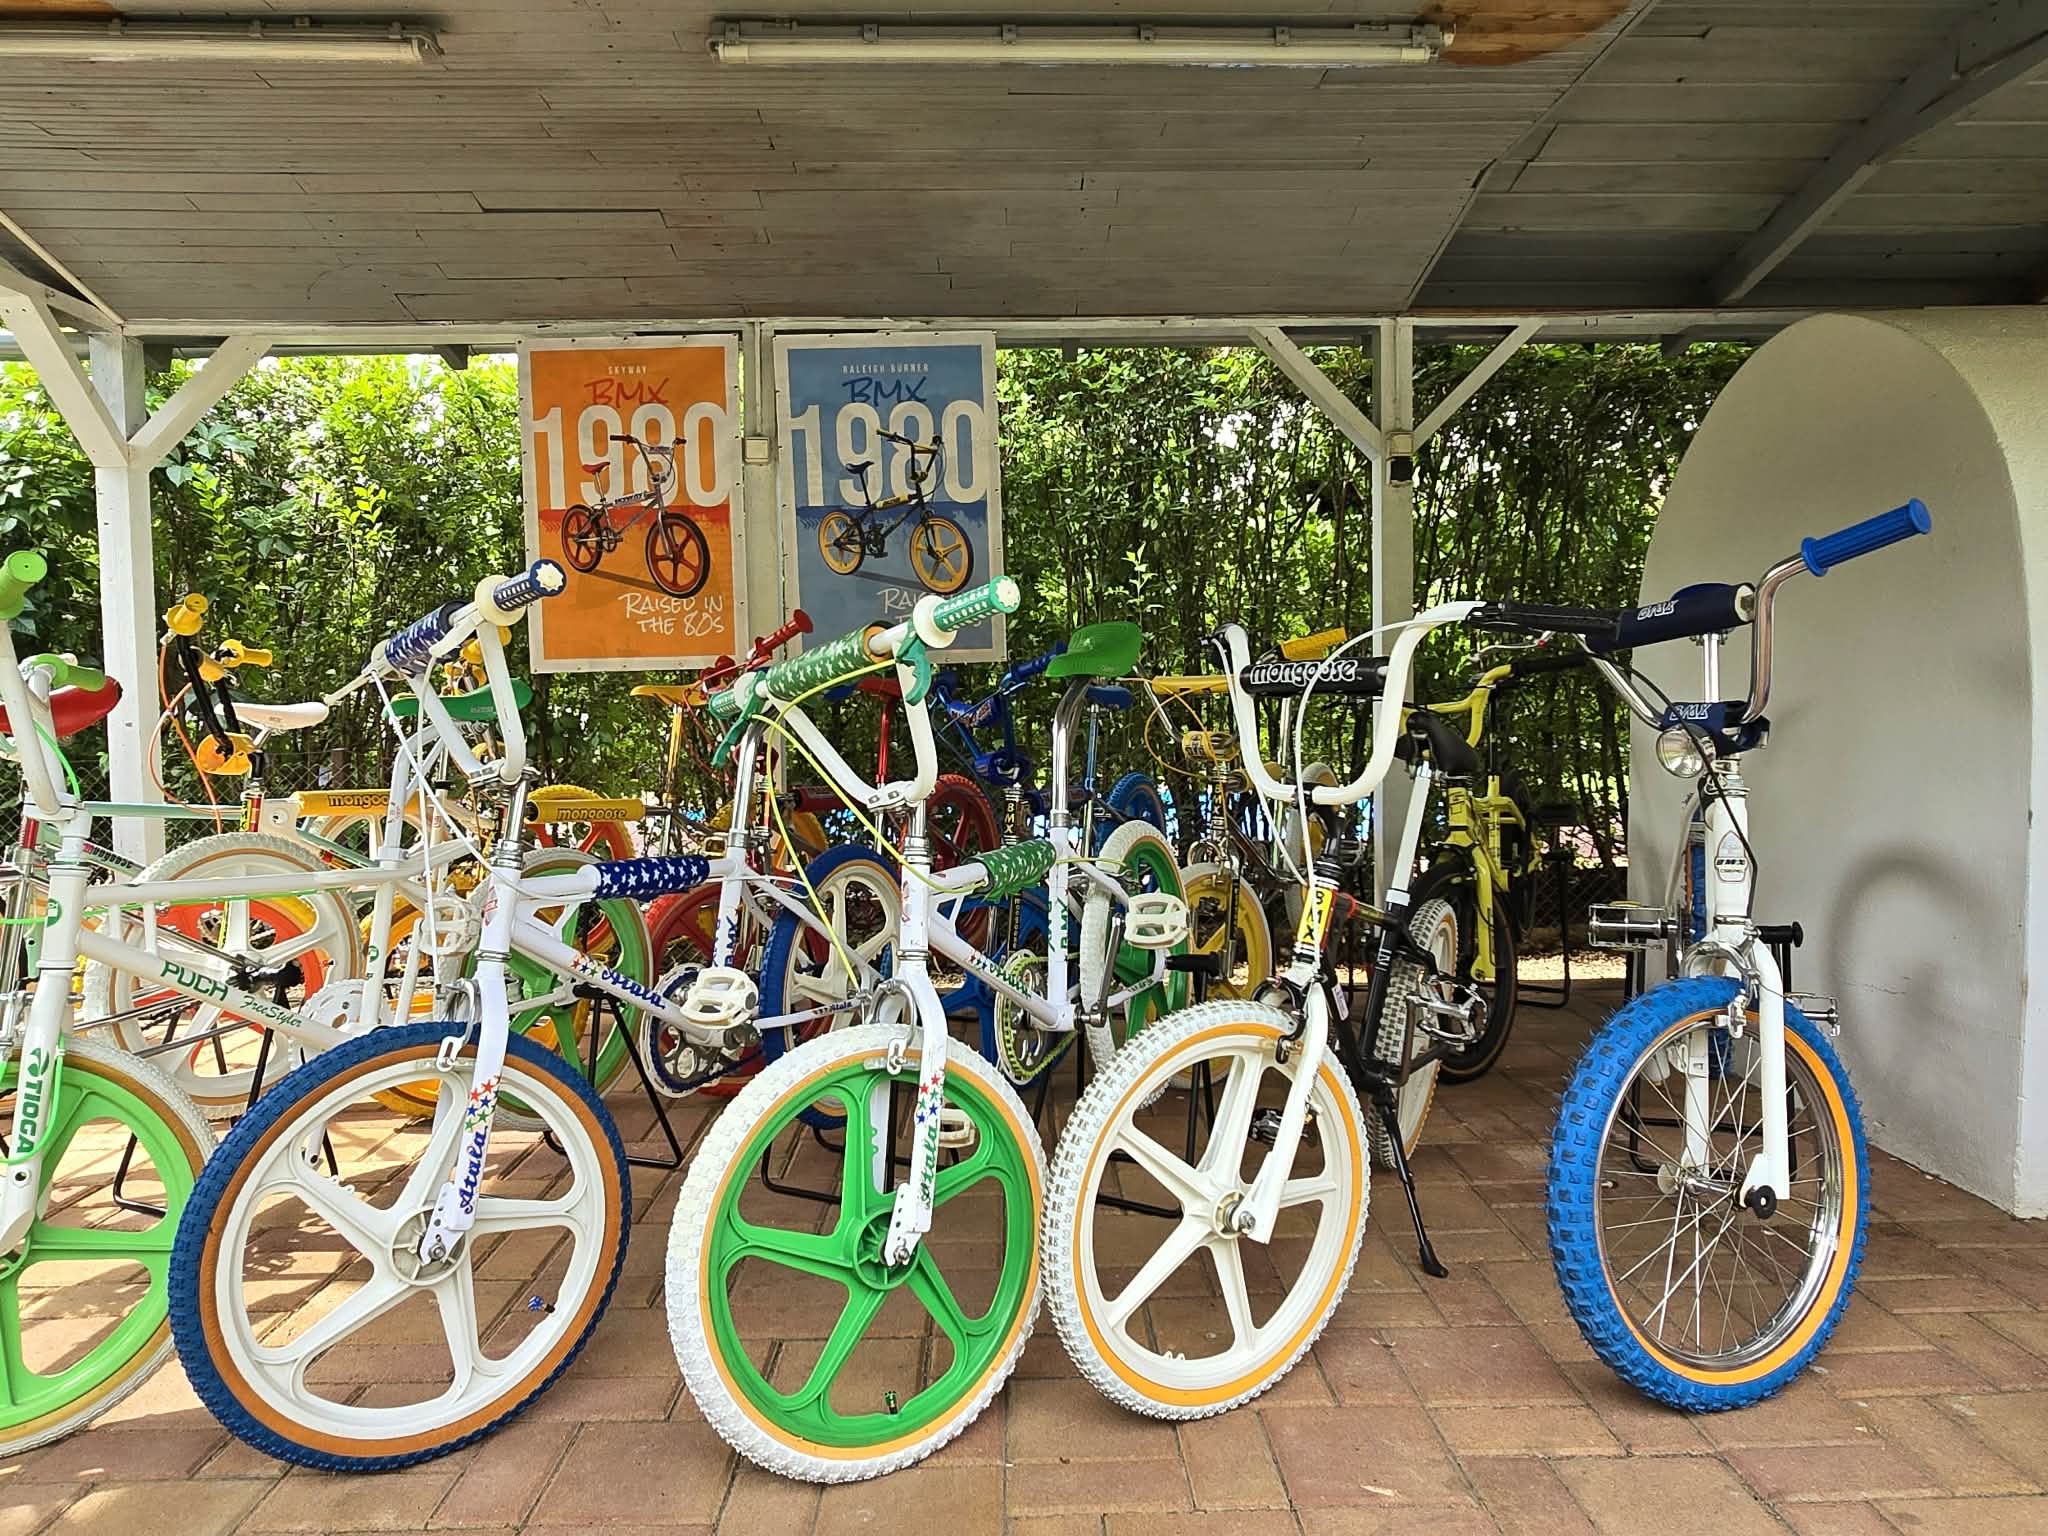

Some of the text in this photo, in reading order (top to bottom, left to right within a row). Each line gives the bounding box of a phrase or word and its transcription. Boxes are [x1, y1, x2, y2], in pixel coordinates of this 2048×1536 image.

[608, 366, 647, 375] SKYWAY
[842, 363, 885, 375] RALEIGH
[583, 378, 669, 408] BMX
[842, 376, 927, 406] BMX
[532, 402, 729, 509] 1980
[790, 400, 987, 506] 1980
[618, 592, 723, 618] RAISED IN
[636, 617, 677, 634] THE
[1251, 659, 1358, 686] mongoose
[328, 793, 390, 808] mongoo
[556, 808, 627, 821] mongoose
[1004, 802, 1016, 834] BMX
[160, 961, 229, 1001] PUCH
[17, 1080, 42, 1153] TIOGA
